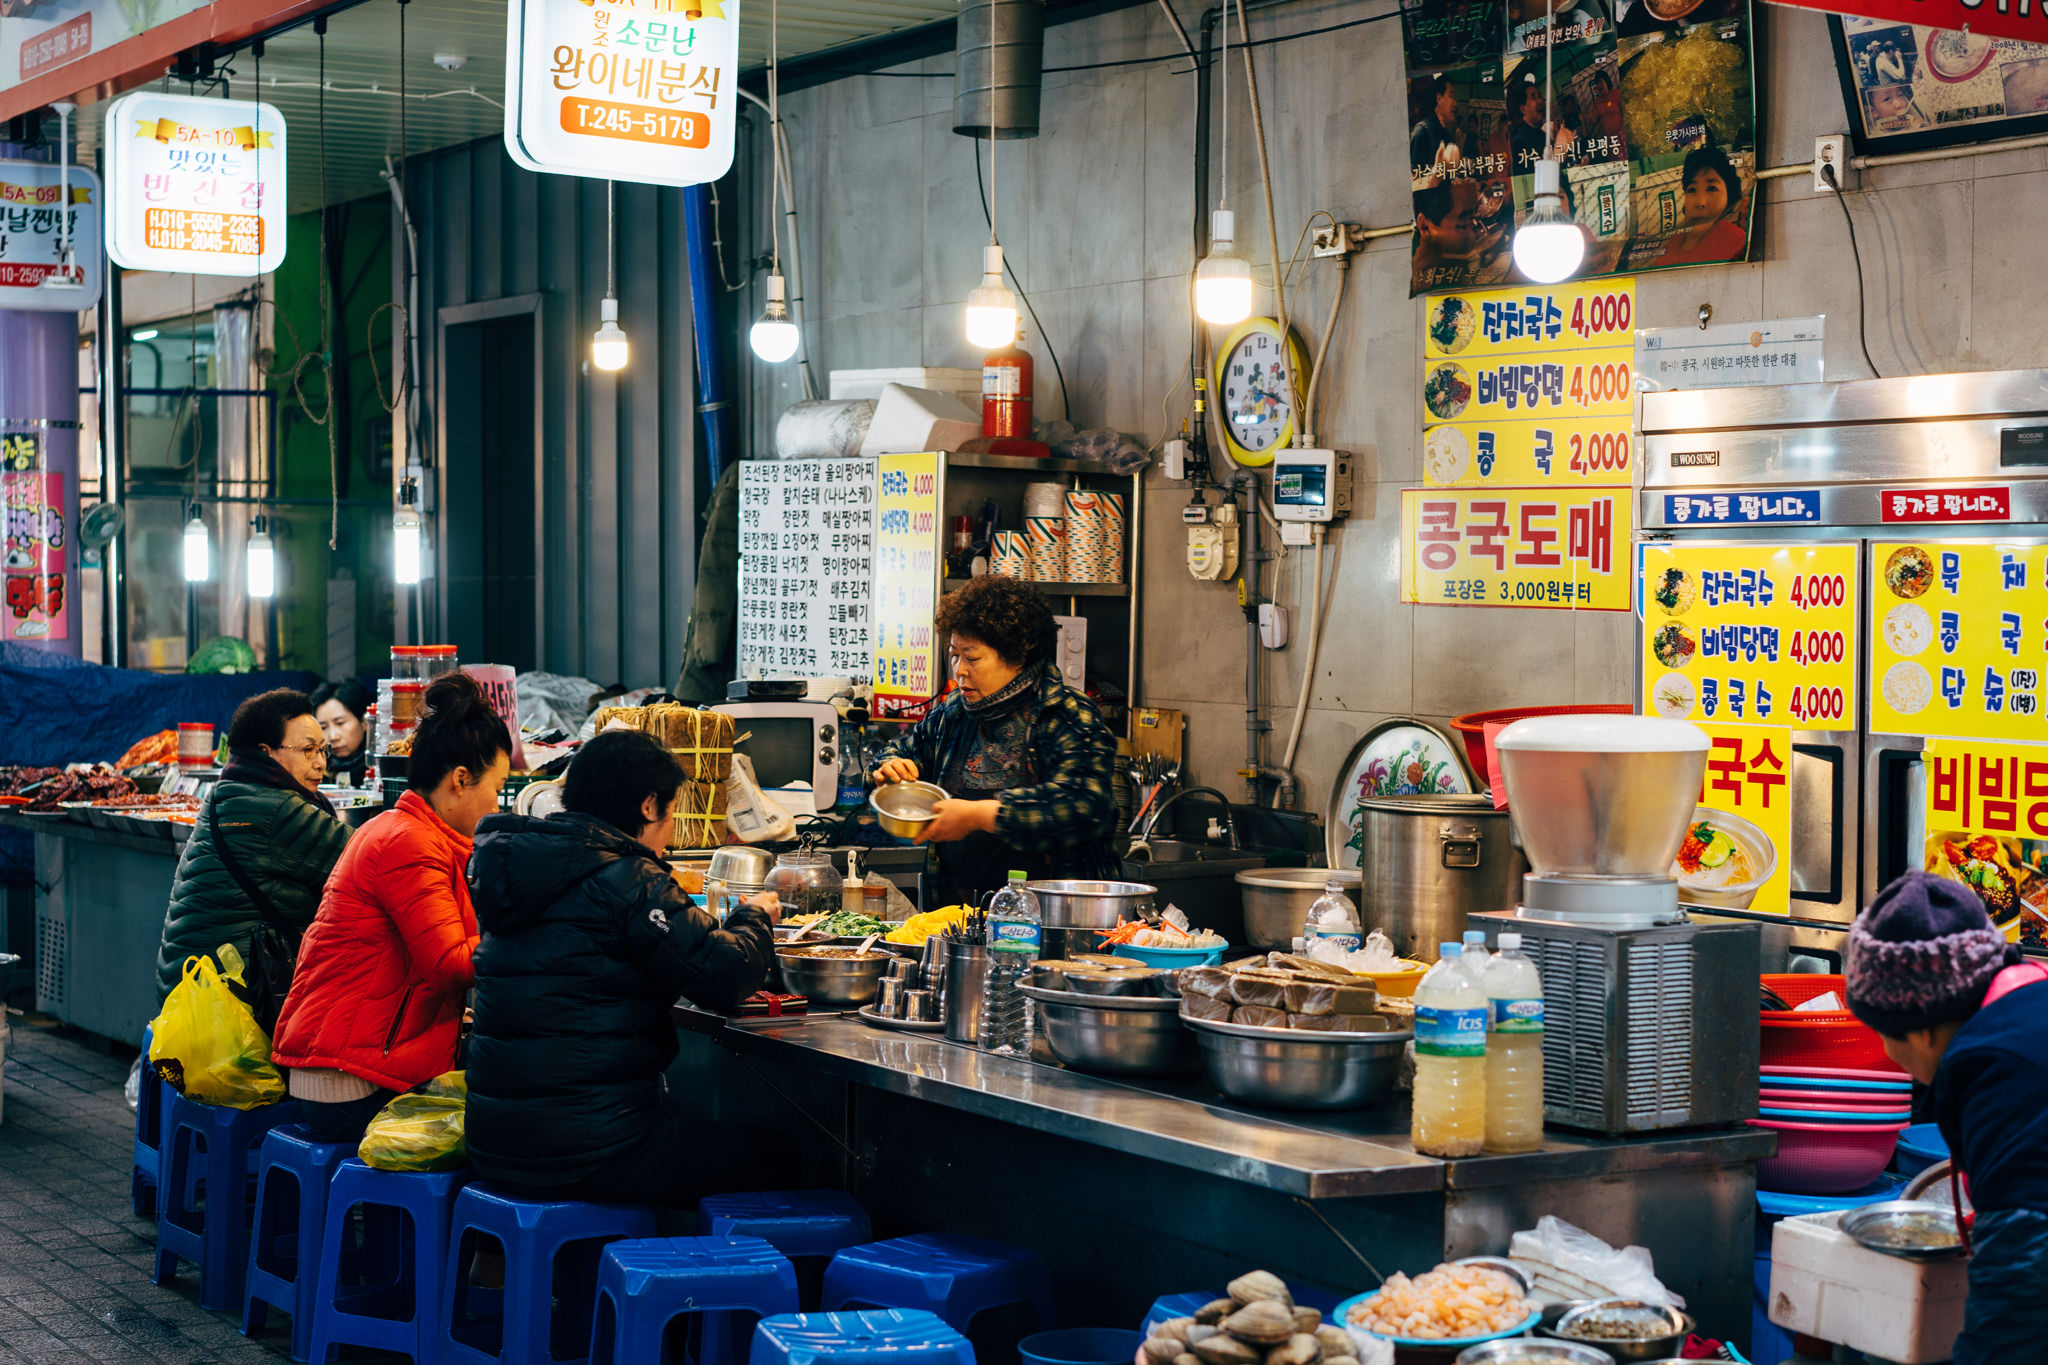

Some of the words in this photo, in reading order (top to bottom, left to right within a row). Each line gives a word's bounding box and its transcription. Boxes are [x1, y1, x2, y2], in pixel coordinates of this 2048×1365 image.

[592, 10, 610, 47] 원조
[616, 20, 696, 56] 소문난
[550, 45, 720, 110] 완이네분식
[578, 104, 694, 140] T.245-5179
[178, 127, 234, 146] 5A-10
[169, 150, 241, 175] 맛있는
[1518, 149, 1540, 168] 가수
[1549, 141, 1581, 164] 규식!
[1585, 135, 1621, 158] 부평동
[1411, 165, 1434, 180] 가수
[1437, 159, 1472, 180] 최규식!
[1475, 153, 1507, 175] 부평동
[5, 186, 56, 202] 5A-09
[1482, 296, 1563, 343] 잔치국수
[1571, 293, 1631, 339] 4,000
[1244, 346, 1252, 357] 11
[1258, 336, 1268, 349] 12
[1234, 364, 1244, 377] 10
[1702, 356, 1734, 370] 시원하고
[1736, 354, 1760, 369] 따뜻한
[1762, 353, 1778, 368] 한판
[1781, 352, 1797, 367] 대결
[1228, 388, 1235, 400] 9
[1478, 364, 1564, 408] 비빔당면
[1570, 363, 1630, 407] 4,000
[1242, 428, 1248, 440] 7
[1257, 435, 1264, 447] 6
[1570, 432, 1628, 476] 2,000
[745, 464, 780, 482] 조선된장
[784, 464, 821, 482] 전어젓갈
[744, 487, 770, 505] 청국장
[824, 485, 872, 505] (나나스케)
[914, 474, 934, 498] 4,000
[1673, 496, 1730, 522] 콩가루
[1738, 496, 1814, 520] 팝니다.
[1892, 495, 1939, 517] 콩가루
[1943, 494, 2004, 516] 팝니다.
[744, 510, 760, 528] 막장
[783, 510, 810, 528] 창란젓
[912, 512, 933, 536] 4,000
[744, 532, 778, 551] 된장깻잎
[782, 533, 820, 551] 오징어젓
[1418, 499, 1612, 573] 콩국도매
[744, 555, 778, 573] 된장콩잎
[782, 556, 809, 574] 낙지젓
[743, 577, 777, 596] 양념깻잎
[831, 580, 870, 600] 배추김치
[1444, 579, 1486, 600] 포장은
[1500, 581, 1591, 603] 3,000원부터
[1702, 569, 1774, 607] 잔치국수
[1790, 575, 1845, 610] 4,000
[780, 601, 808, 620] 명란젓
[828, 604, 868, 623] 꼬들빼기
[742, 622, 776, 641] 양념게장
[780, 624, 808, 643] 새우젓
[829, 628, 868, 646] 된장고추
[910, 626, 930, 650] 2,000
[1702, 625, 1779, 662] 비빔당면
[1790, 631, 1844, 666] 4,000
[780, 647, 817, 667] 김장젓국
[830, 651, 870, 670] 젓갈고추
[910, 654, 926, 674] 1,000
[910, 675, 928, 695] 5,000
[1790, 686, 1844, 722] 4,000
[1697, 737, 1786, 808] 국수
[1007, 927, 1036, 937] 삼다수
